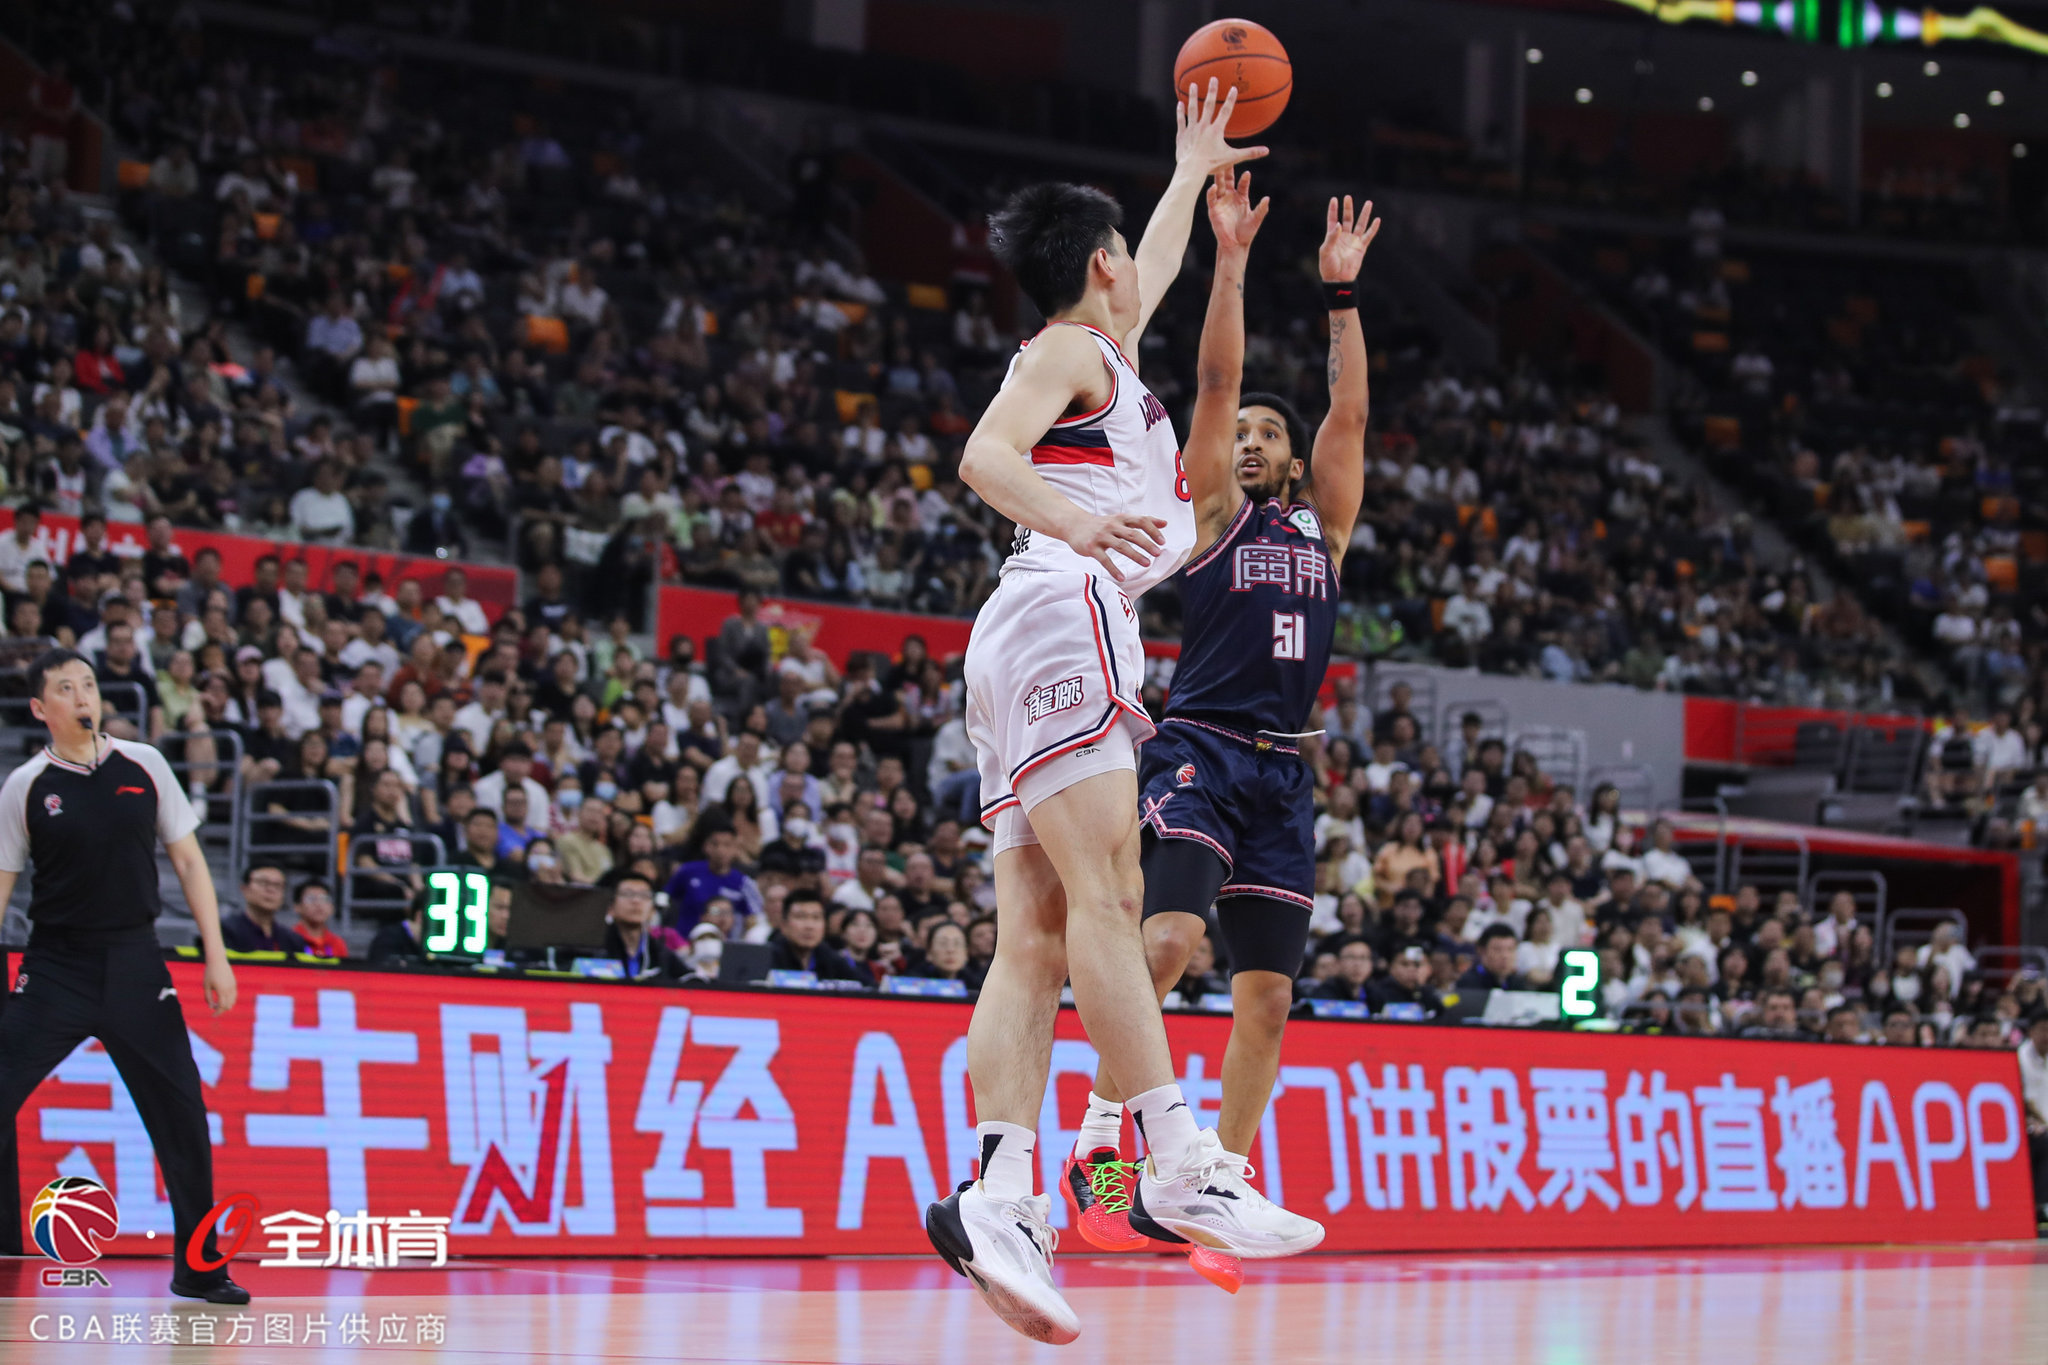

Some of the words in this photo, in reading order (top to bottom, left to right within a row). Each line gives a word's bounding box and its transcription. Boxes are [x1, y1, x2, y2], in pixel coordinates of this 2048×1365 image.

[1229, 536, 1327, 601] 廣東
[1272, 610, 1305, 661] 51
[427, 872, 489, 954] 33
[1562, 950, 1599, 1016] 2
